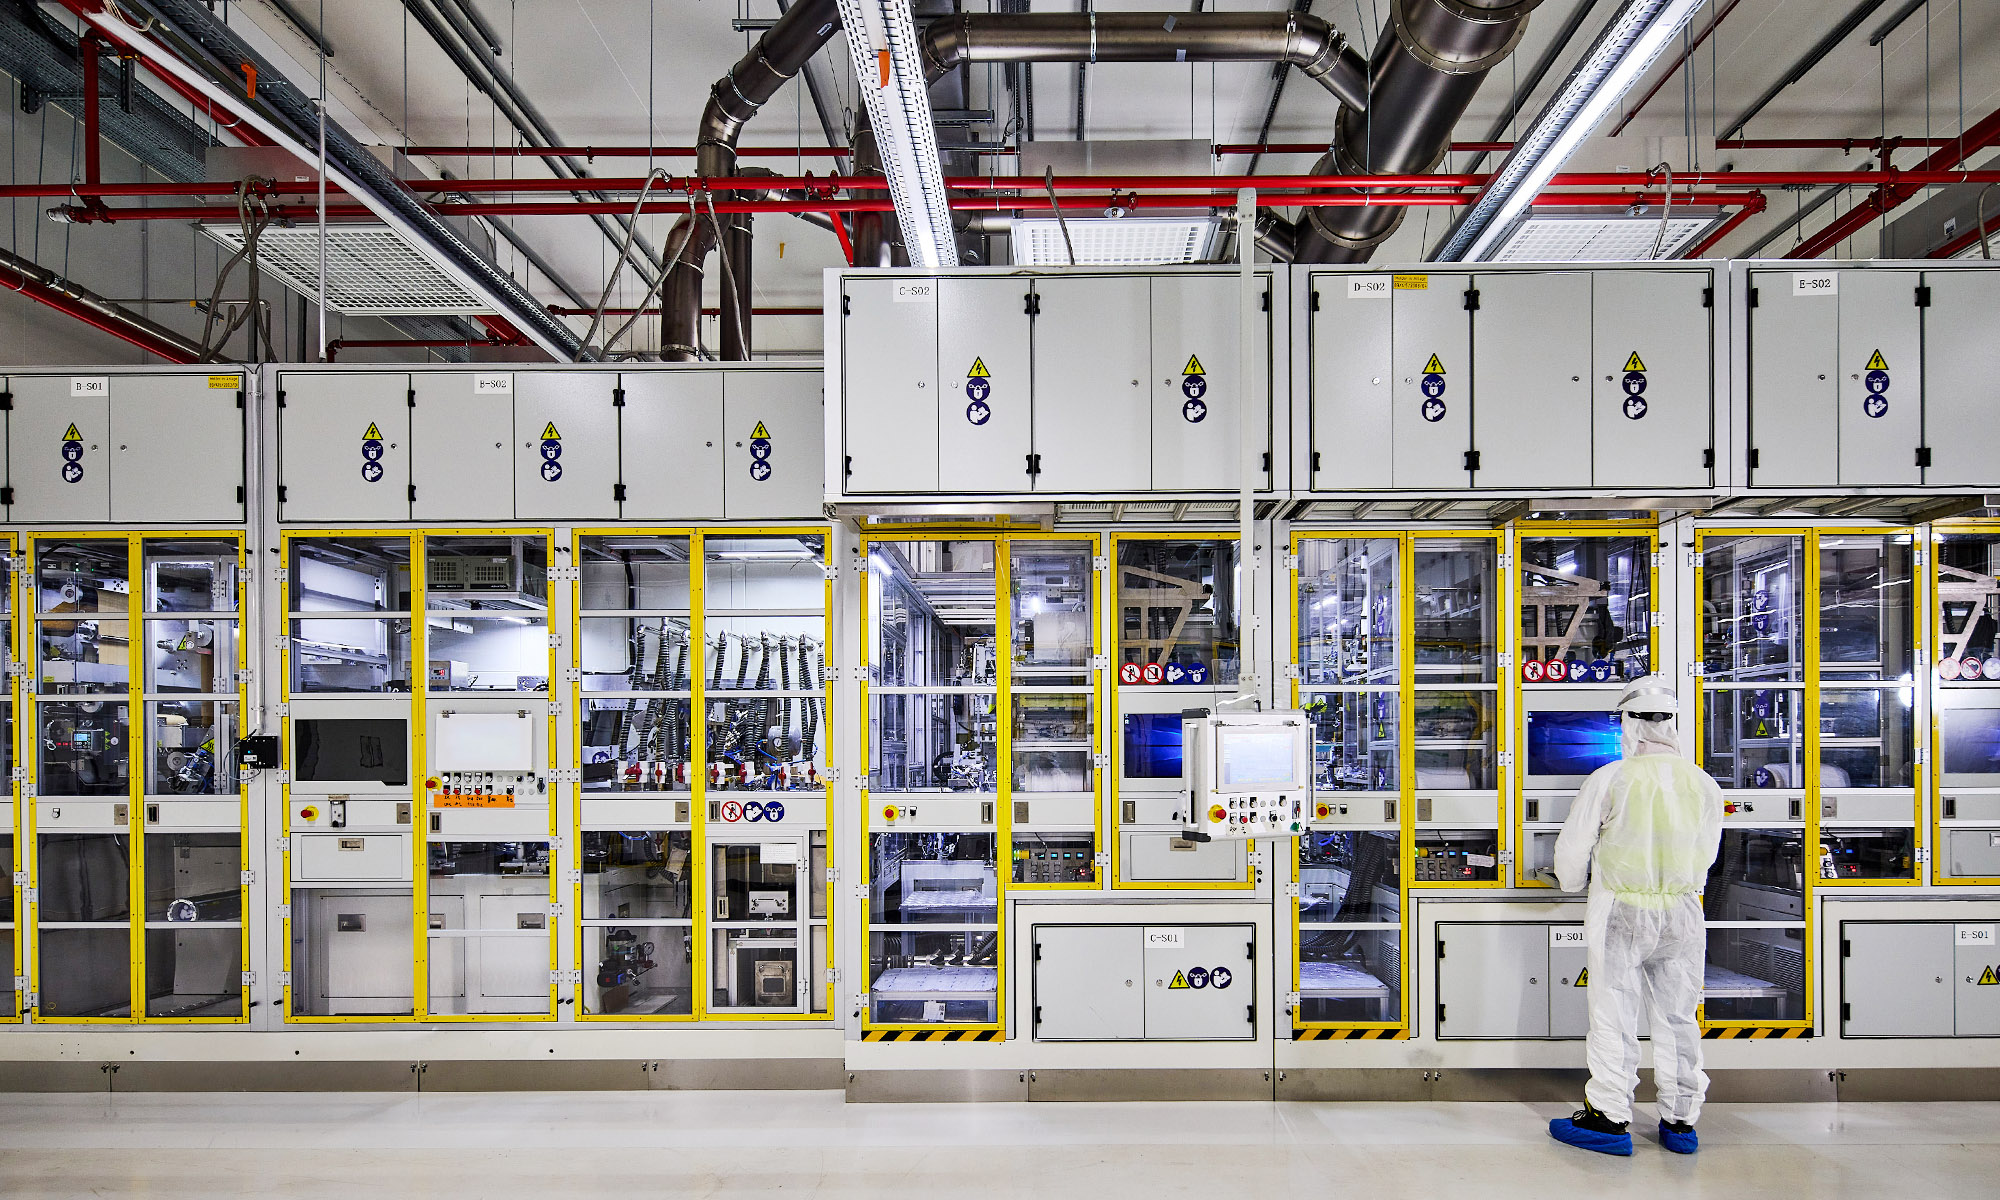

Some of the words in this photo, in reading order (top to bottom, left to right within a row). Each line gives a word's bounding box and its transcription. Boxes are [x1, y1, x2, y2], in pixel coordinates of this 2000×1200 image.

[1353, 282, 1385, 292] D-S02
[1799, 278, 1831, 289] E-S02
[899, 286, 930, 296] C-S02
[75, 382, 103, 391] B-S01
[479, 379, 507, 389] B-S02
[1150, 934, 1178, 943] C-S01
[1555, 932, 1584, 941] D-S01
[1960, 930, 1989, 940] E-S01
